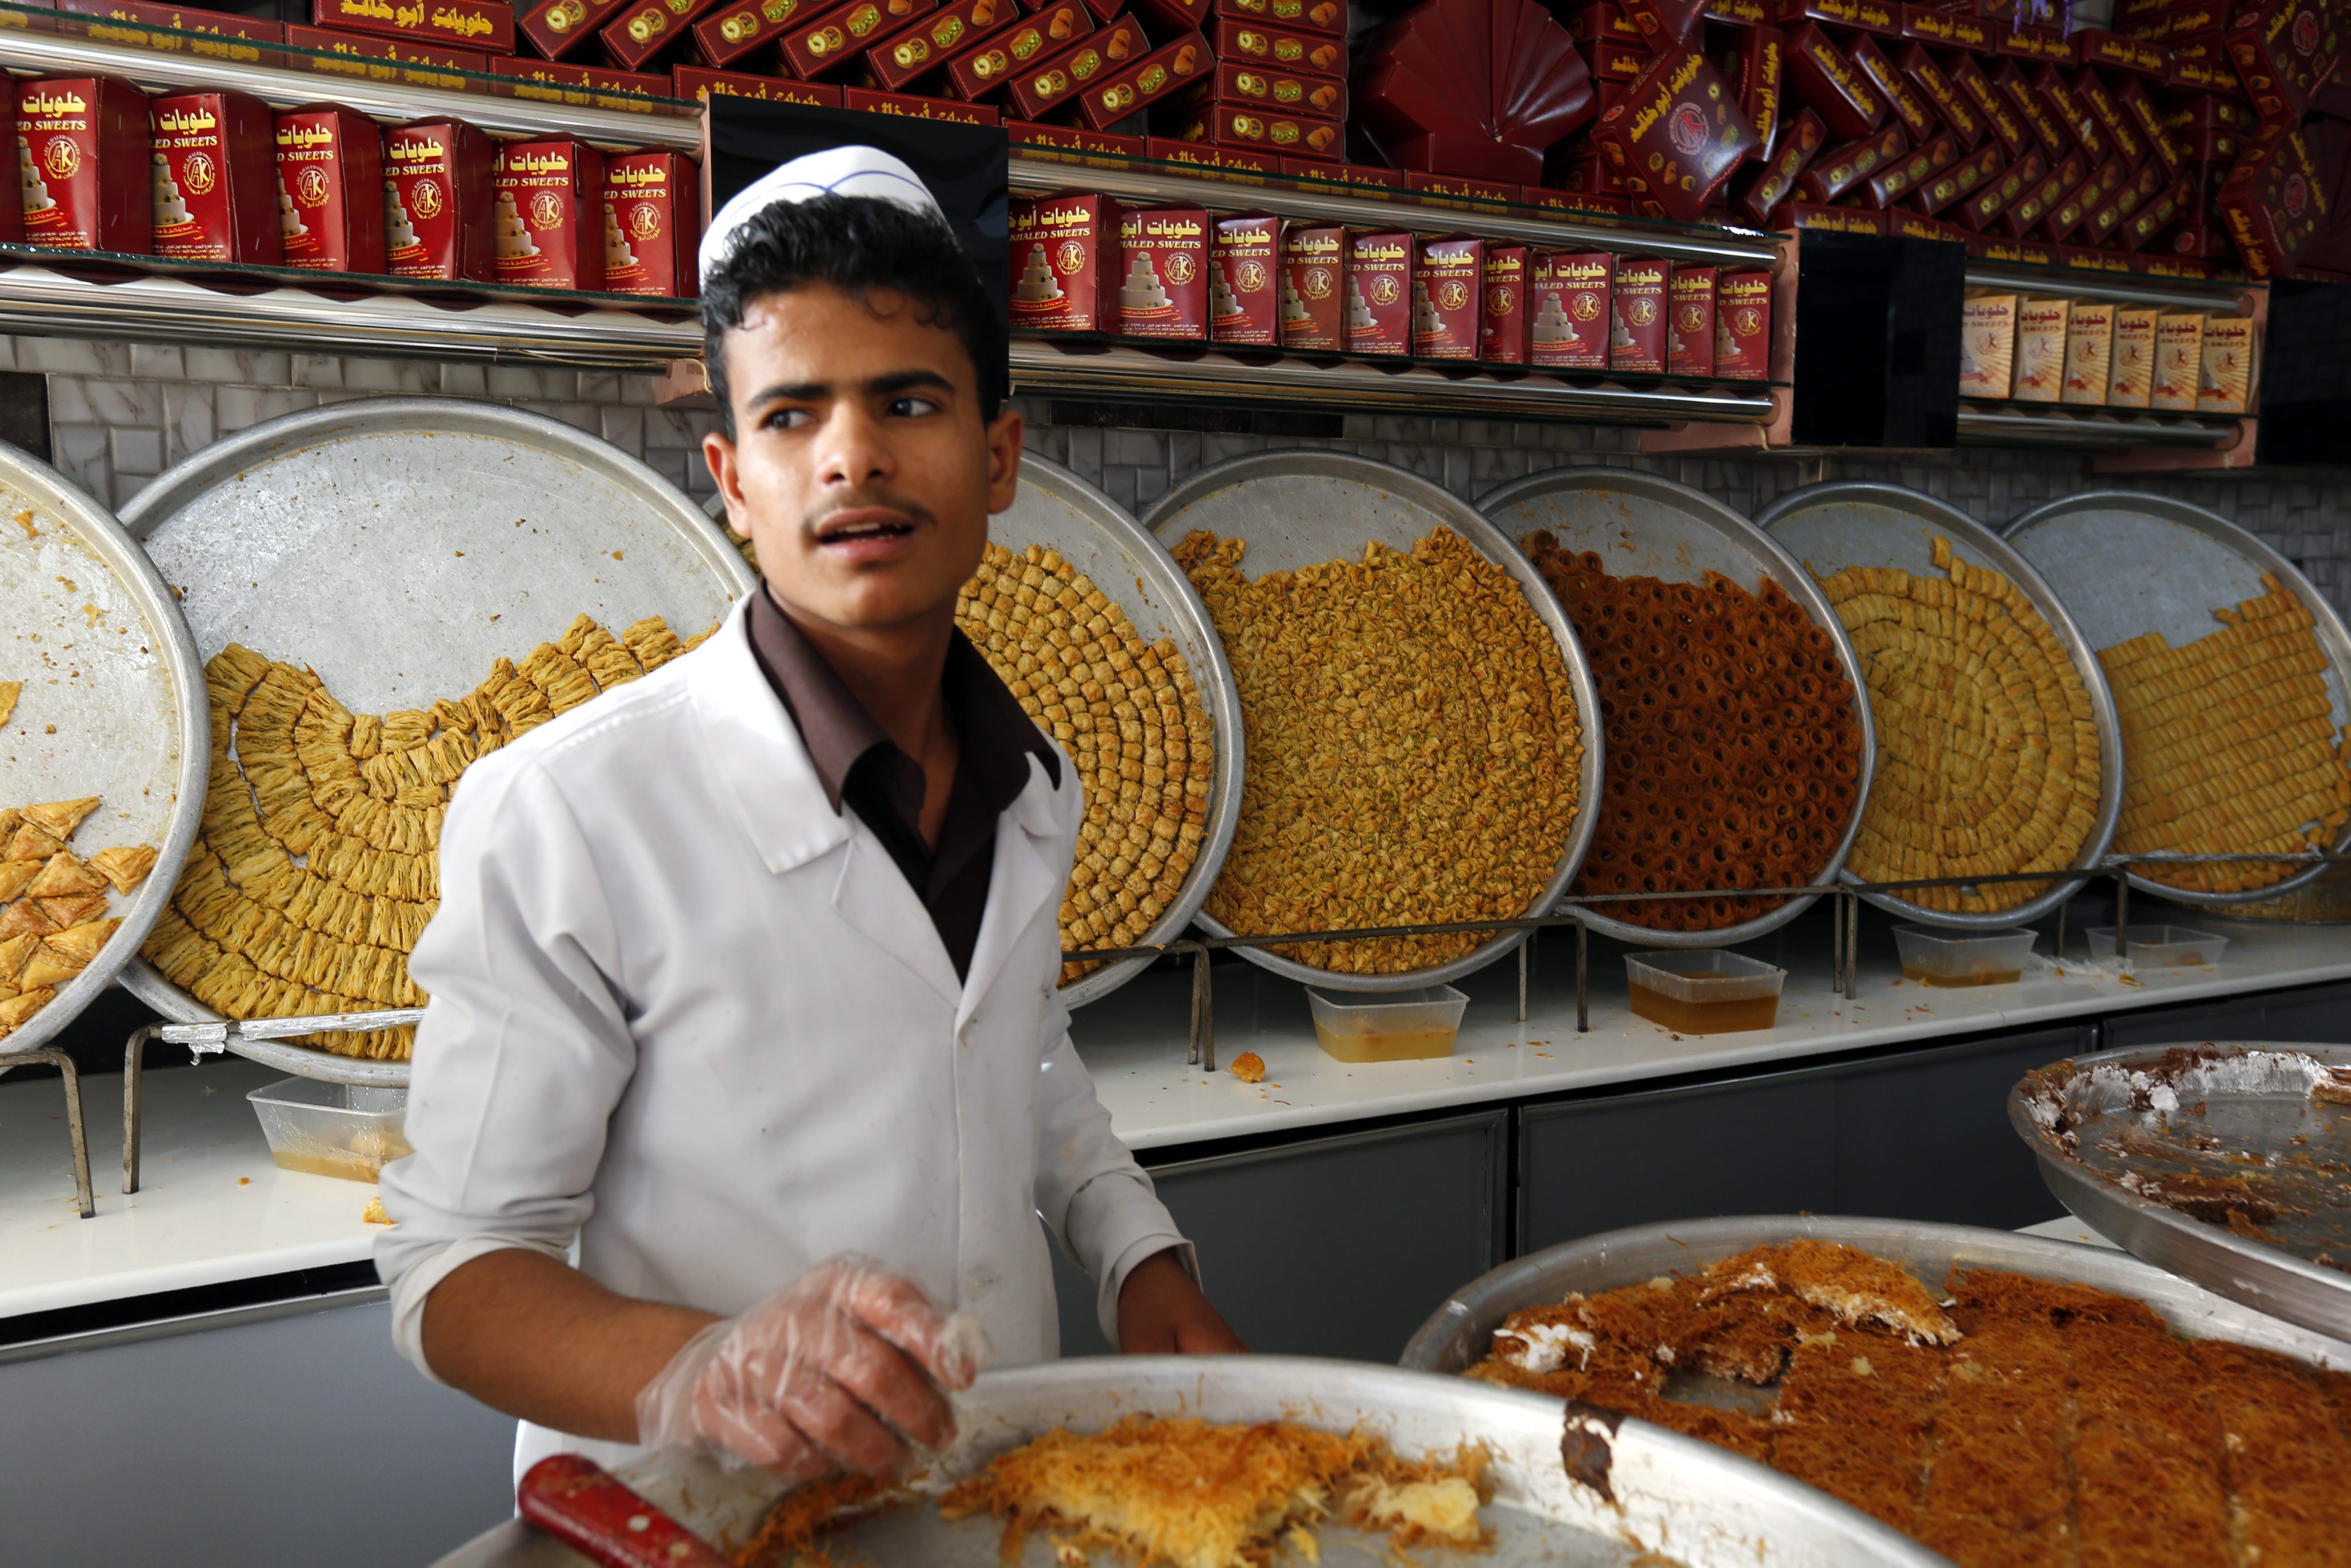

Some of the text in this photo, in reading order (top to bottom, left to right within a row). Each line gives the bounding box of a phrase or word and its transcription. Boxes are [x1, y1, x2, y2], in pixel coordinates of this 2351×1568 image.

[432, 7, 493, 37] حلويات
[22, 91, 86, 118] حلويات
[34, 120, 87, 131] SWEETS
[160, 107, 216, 135] حلويات
[174, 136, 218, 148] SWEETS
[277, 123, 333, 149] حلويات
[288, 150, 333, 161] SWEETS
[390, 136, 444, 163] حلويات
[402, 163, 445, 175] SWEETS
[510, 151, 568, 176] حلويات
[521, 177, 569, 187] SWEETS
[610, 164, 666, 188] حلويات
[621, 189, 666, 199] SWEETS
[1017, 204, 1037, 231] أبو
[1041, 205, 1091, 228] حلويات
[1120, 213, 1202, 239] حلويات أبو
[1010, 228, 1090, 242] KHALED SWEETS
[1157, 240, 1201, 249] SWEETS
[1219, 227, 1271, 247] حلويات
[1228, 249, 1271, 257] SWEETS
[1288, 235, 1339, 255] حلويات
[1354, 243, 1405, 262] حلويات
[1297, 256, 1339, 264] SWEETS
[1424, 249, 1474, 268] حلويات
[1433, 269, 1473, 278] SWEETS
[1557, 262, 1607, 280] حلويات
[1616, 267, 1663, 286] حلويات
[1673, 293, 1712, 301] SWEETS
[1720, 280, 1768, 297] حلويات
